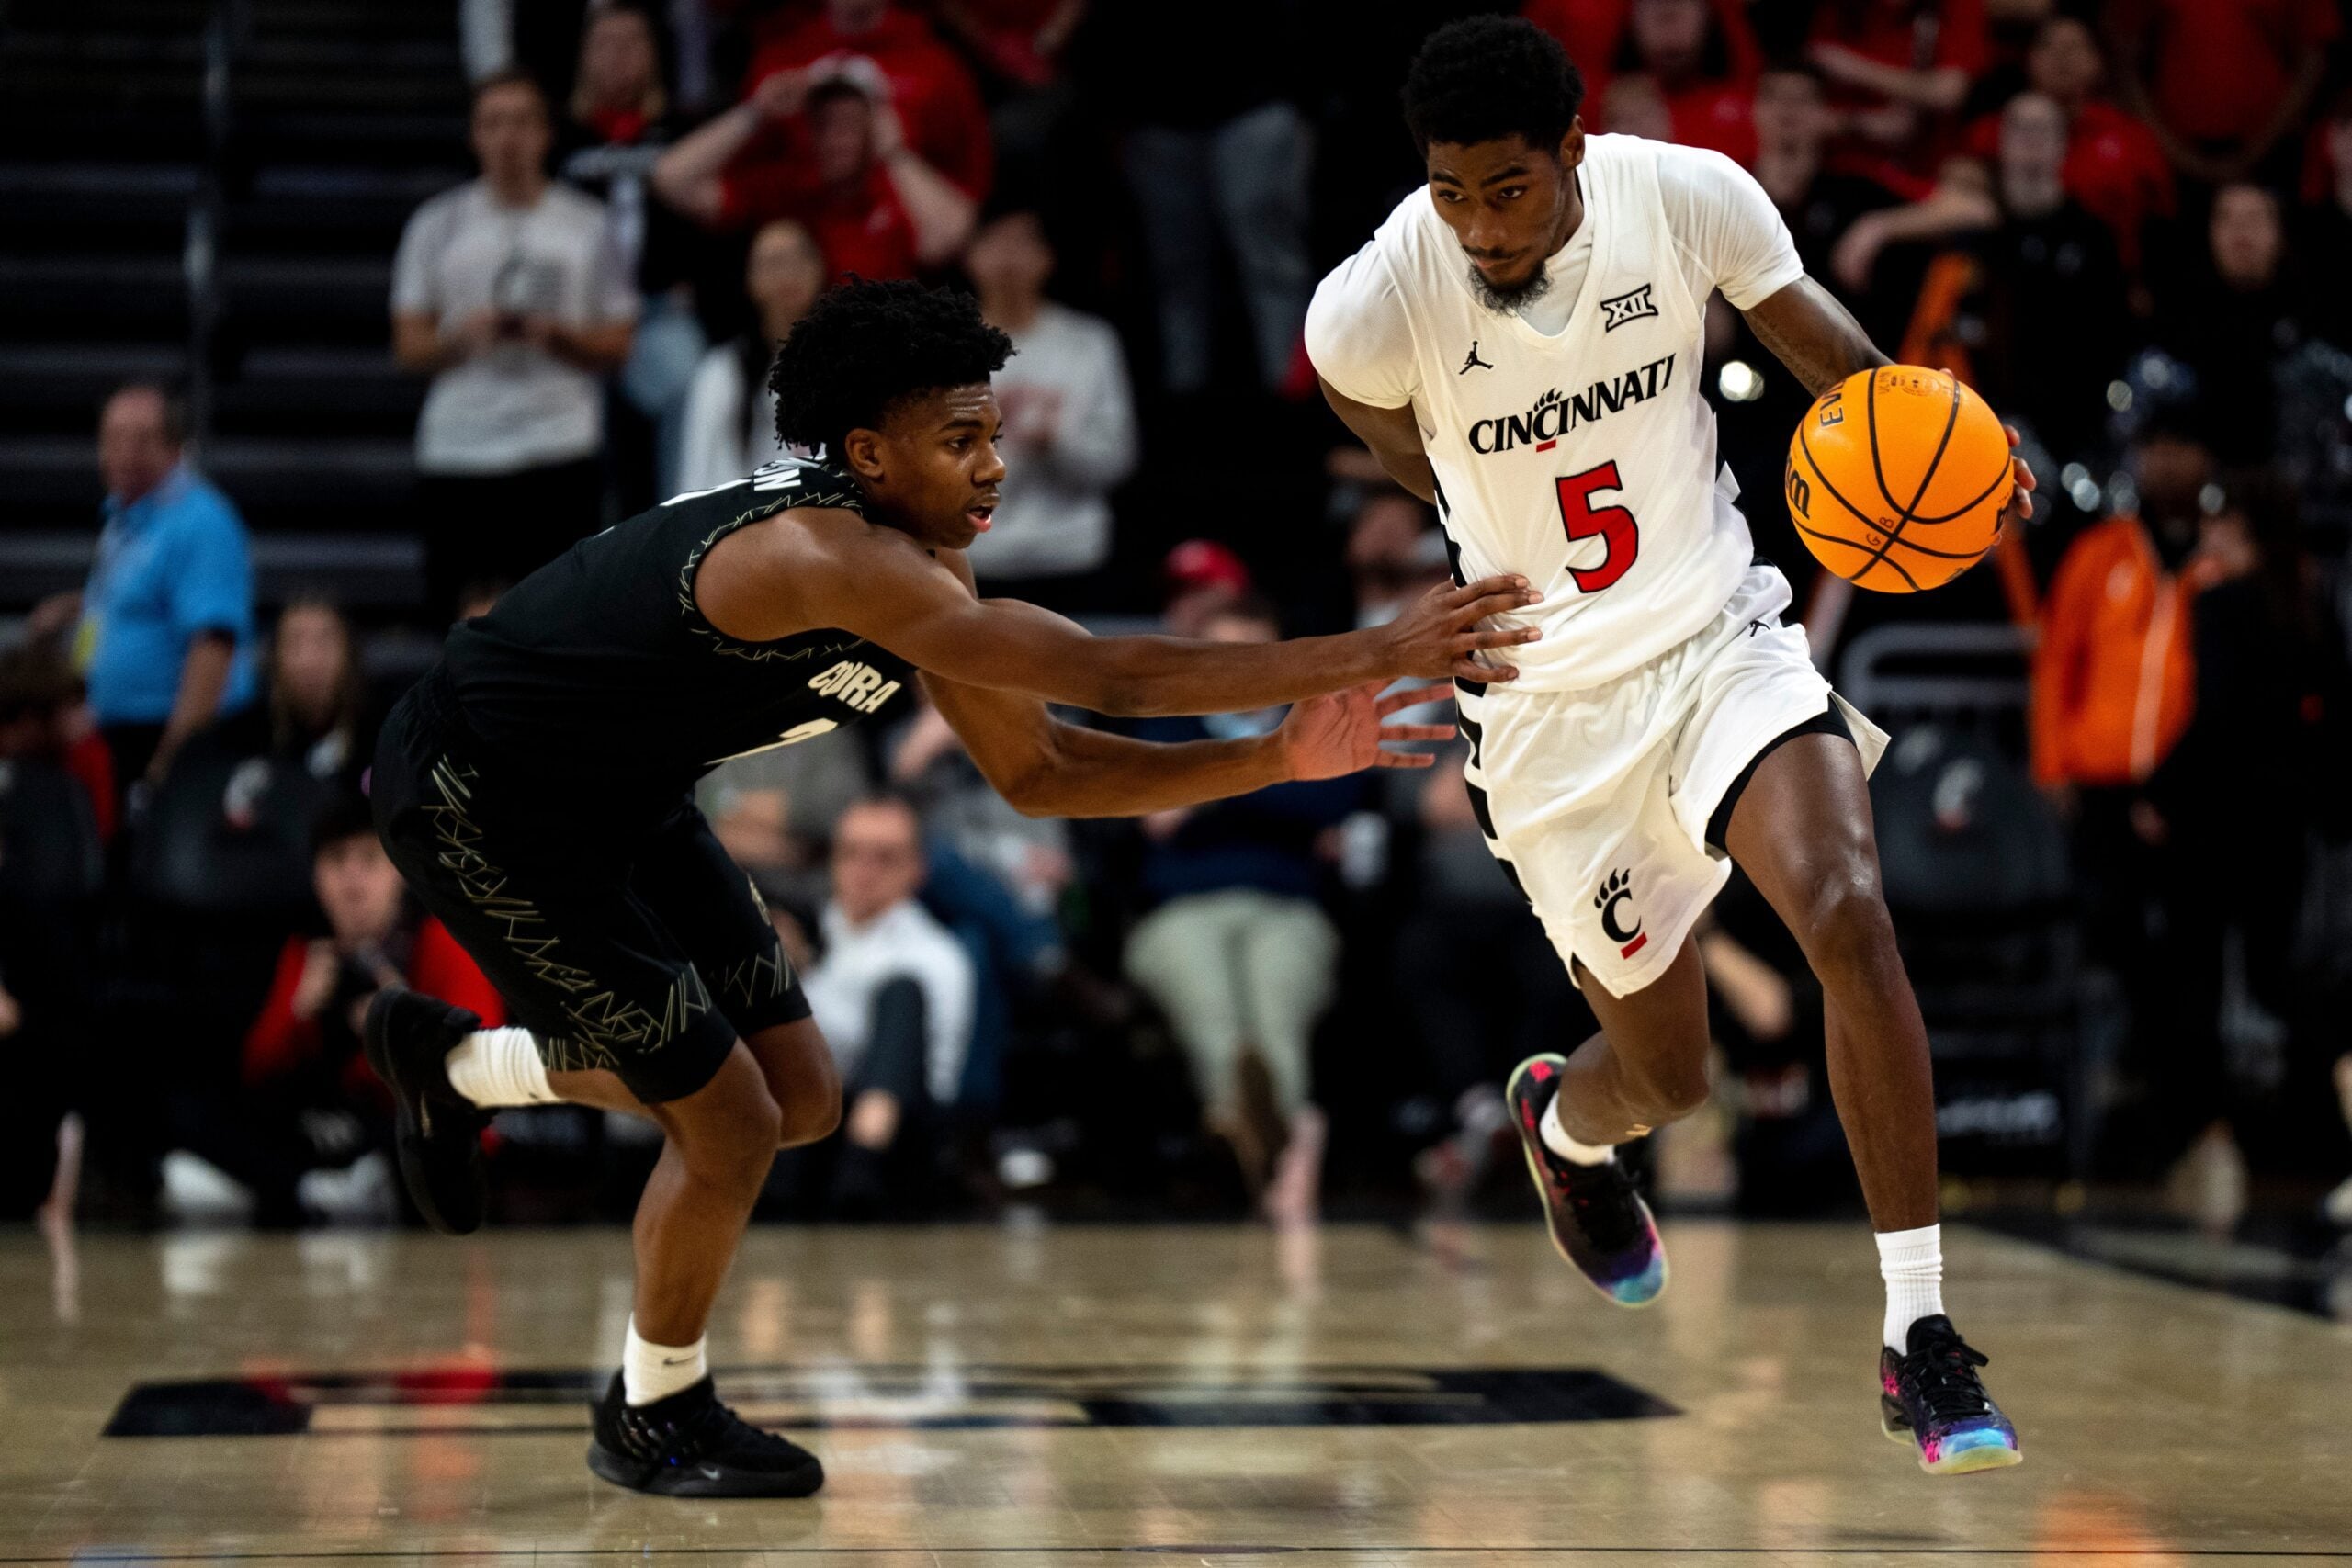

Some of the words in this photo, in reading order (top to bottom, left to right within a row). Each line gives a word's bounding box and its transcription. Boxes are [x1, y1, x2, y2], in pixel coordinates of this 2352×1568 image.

[1600, 283, 1658, 333] XII
[1469, 353, 1676, 454] CINCINNATI
[1555, 459, 1639, 593] 5
